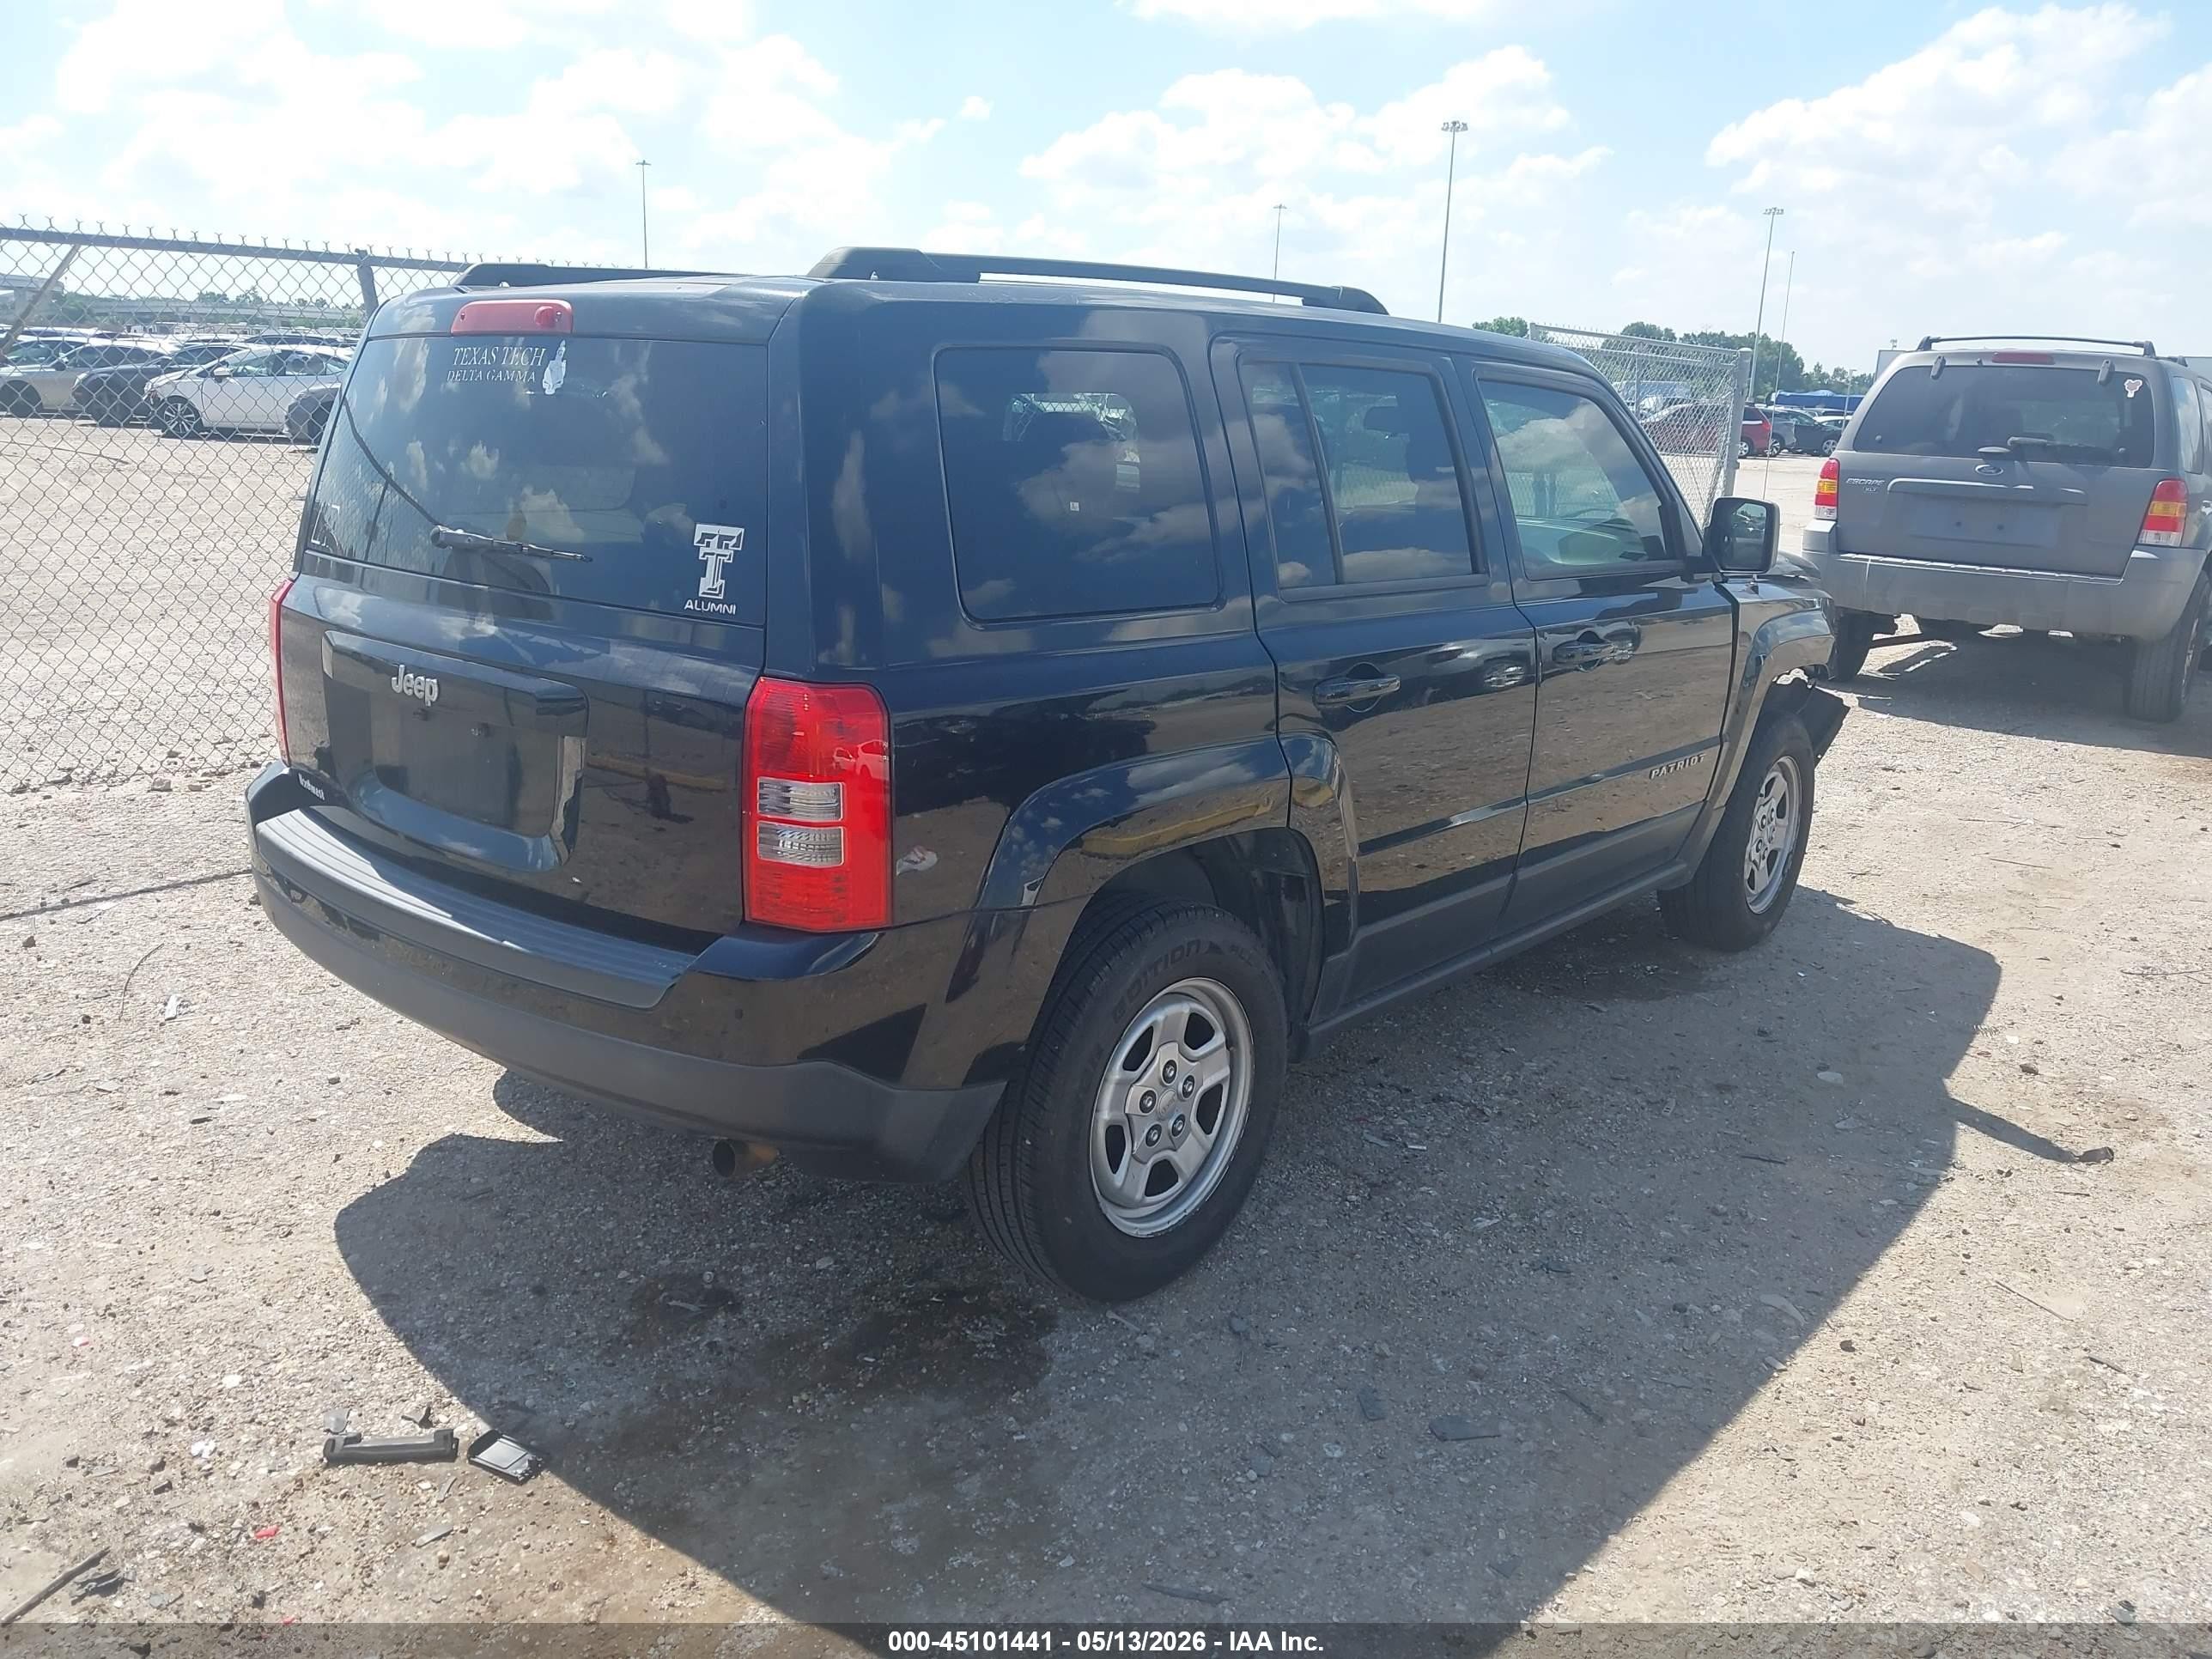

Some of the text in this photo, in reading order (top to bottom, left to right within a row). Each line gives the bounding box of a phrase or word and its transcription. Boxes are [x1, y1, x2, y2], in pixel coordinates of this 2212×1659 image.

[453, 347, 547, 366] TEXAS TECH
[447, 369, 536, 383] DELTA GAMMA
[1845, 477, 1885, 486] ESCAPE
[684, 599, 737, 615] ALUMNI
[391, 664, 439, 707] Jeep
[1650, 753, 1706, 780] PATRIOT
